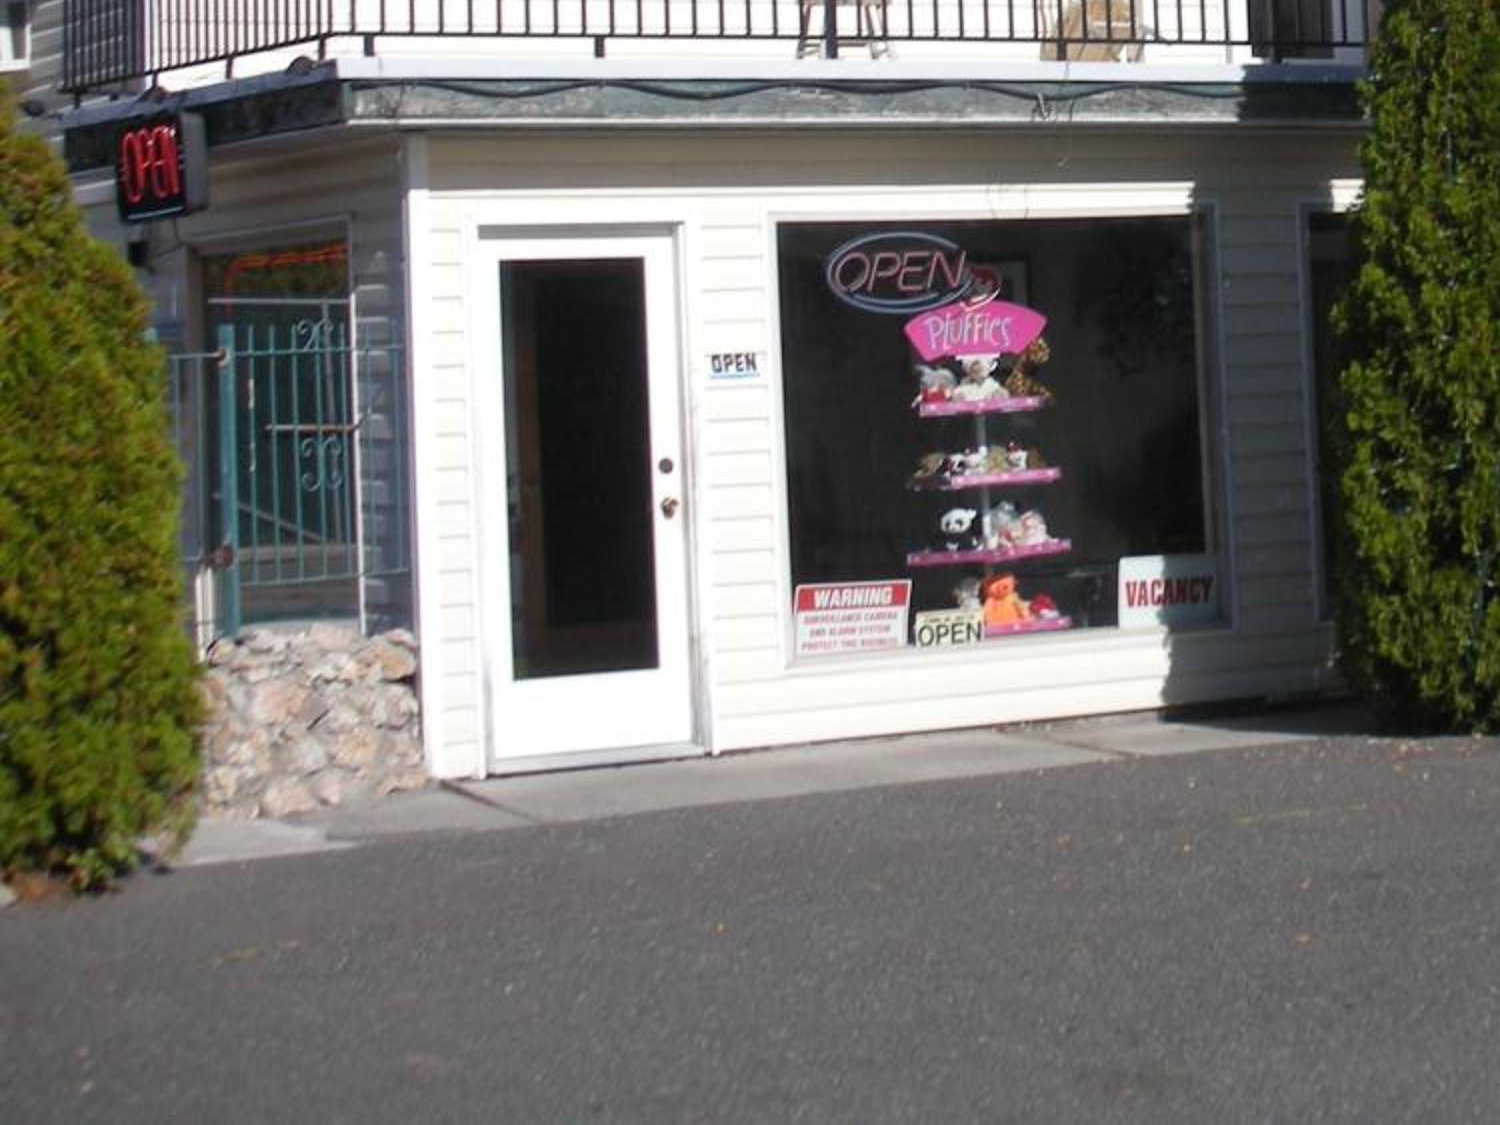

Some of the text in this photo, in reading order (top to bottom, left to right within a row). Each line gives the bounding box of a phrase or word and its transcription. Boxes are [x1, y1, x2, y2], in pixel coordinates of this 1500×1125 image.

[835, 250, 967, 292] OPEN
[711, 352, 757, 373] OPEN
[814, 586, 893, 609] WARNING
[1126, 576, 1213, 607] VACANCY
[918, 621, 981, 647] OPEN
